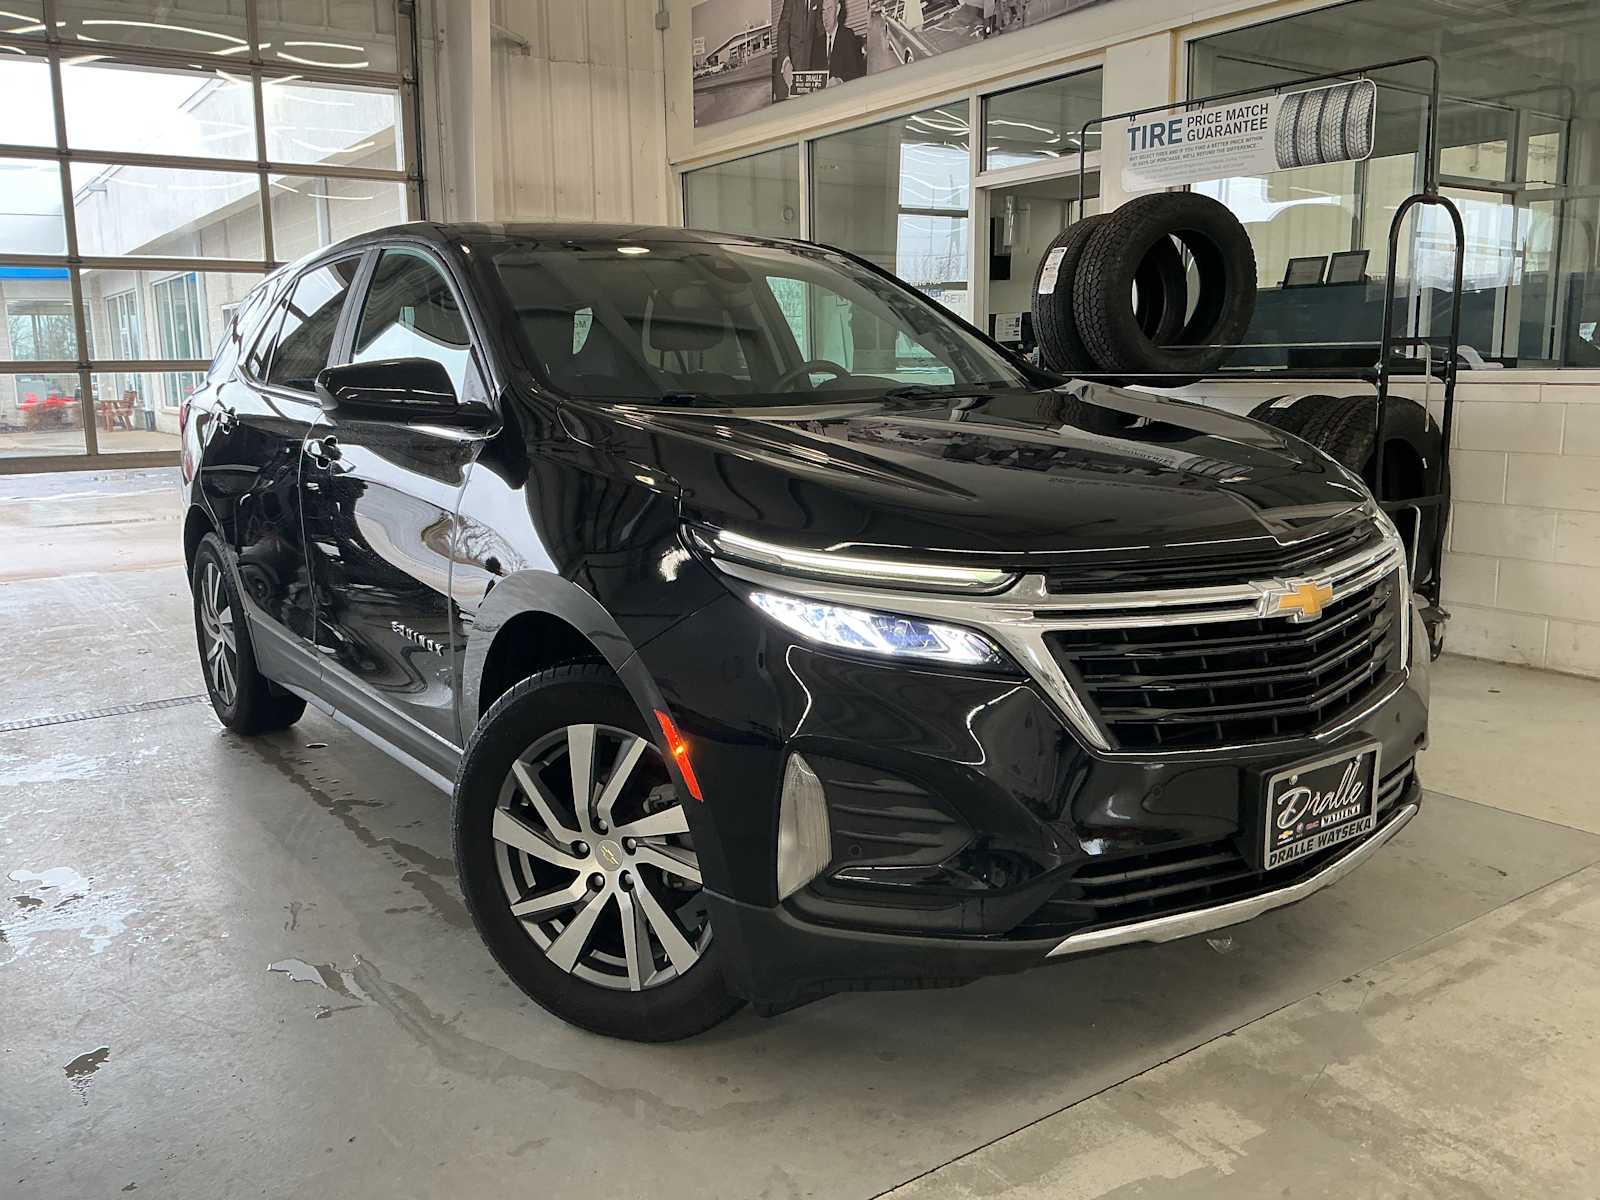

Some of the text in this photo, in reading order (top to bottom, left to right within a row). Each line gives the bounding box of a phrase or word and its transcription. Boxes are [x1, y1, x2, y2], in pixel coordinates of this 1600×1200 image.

[1187, 103, 1269, 128] PRICE MATCH
[1187, 117, 1268, 142] GUARANTEE
[1127, 118, 1183, 151] TIRE
[391, 621, 444, 657] EQUINOX
[1277, 761, 1364, 829] Dralle
[1269, 817, 1372, 866] DRALLE WATSEKA
